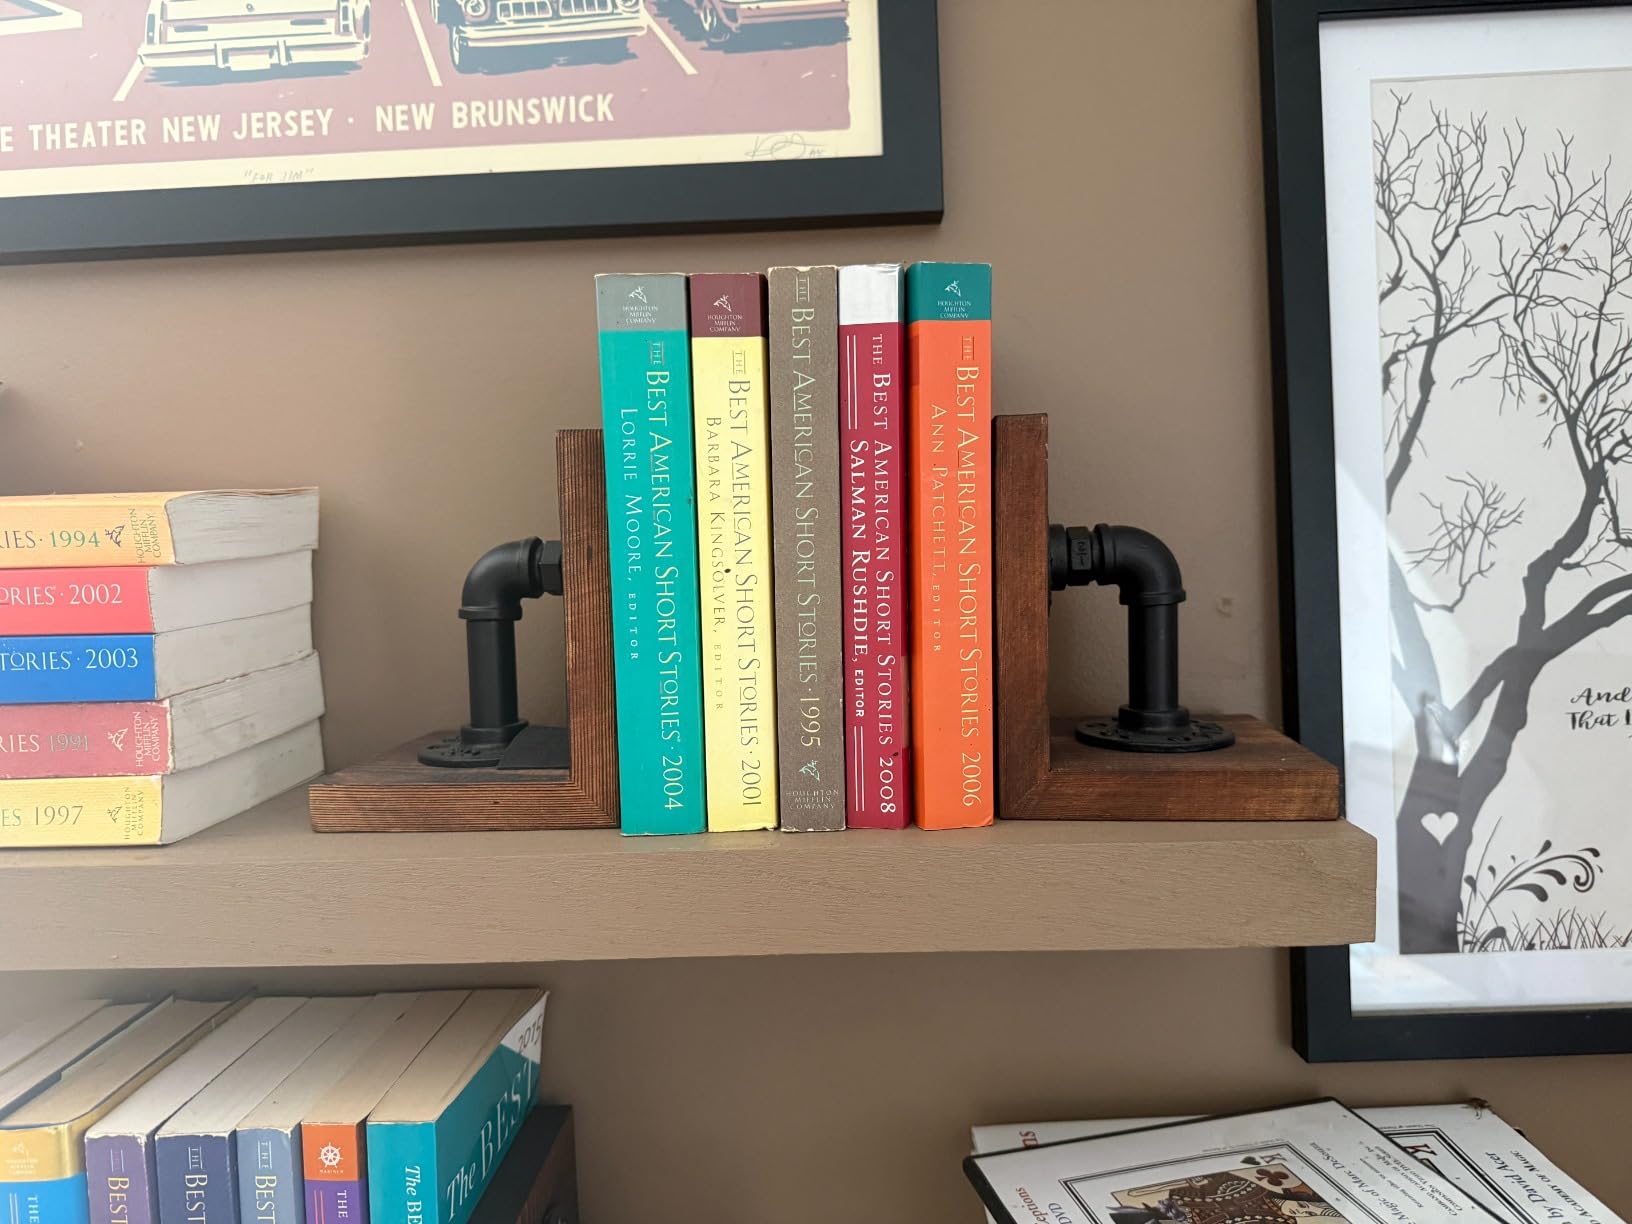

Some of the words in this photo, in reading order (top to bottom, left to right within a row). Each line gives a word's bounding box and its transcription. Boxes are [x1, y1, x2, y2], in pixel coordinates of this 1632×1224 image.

[28, 119, 147, 151] THEATER
[162, 114, 221, 144] NEW
[232, 107, 334, 141] JERSEY
[375, 103, 436, 133] NEW
[452, 93, 615, 129] BRUNSWICK
[651, 341, 662, 365] THE
[734, 351, 743, 375] THE
[791, 307, 815, 365] BEST
[872, 333, 883, 365] THE
[963, 336, 973, 361] THE
[646, 370, 670, 427] BEST
[728, 379, 751, 437] BEST
[872, 373, 891, 430] BEST
[956, 366, 980, 423] BEST
[620, 408, 639, 481] LORRIE
[793, 370, 816, 498] AMERICAN
[931, 404, 948, 454] ANN
[706, 417, 722, 502] BARBARA
[649, 432, 673, 557] AMERICAN
[731, 440, 754, 565] AMERICAN
[850, 439, 869, 540] SALMAN
[874, 440, 893, 561] AMERICAN
[957, 428, 980, 555] AMERICAN
[49, 530, 101, 549] 1994
[128, 508, 147, 564] HOUGHTON
[139, 519, 153, 553] MIFFLIN
[147, 512, 161, 558] COMPANY
[624, 494, 643, 581] MOORE,
[795, 506, 819, 589] SHORT
[932, 467, 949, 577] PATCHETT,
[69, 583, 123, 605] 2002
[710, 511, 726, 633] KINGSOLVER,
[628, 593, 639, 660] EDITOR
[654, 566, 679, 646] SHORT
[735, 573, 758, 653] SHORT
[851, 550, 871, 662] RUSHDIE,
[875, 570, 894, 645] SHORT
[932, 584, 942, 652] EDITOR
[958, 563, 982, 644] SHORT
[85, 648, 139, 669] 2003
[798, 593, 821, 684] STORIES
[713, 644, 724, 710] EDITOR
[738, 658, 761, 746] STORIES
[854, 669, 865, 718] EDITOR
[877, 654, 896, 746] STORIES
[959, 647, 983, 738] STORIES
[1570, 687, 1631, 706] And
[49, 734, 89, 753] 1991
[132, 711, 144, 767] HOUGHTON
[143, 722, 153, 757] MIFFLIN
[151, 717, 161, 762] COMPANY
[799, 698, 821, 748] 1995
[1565, 710, 1620, 730] That
[662, 755, 685, 811] 2004
[741, 759, 762, 806] 2001
[879, 757, 896, 814] 2008
[961, 751, 983, 808] 2006
[34, 806, 84, 826] 1997
[517, 1013, 544, 1053] 2015
[191, 1148, 200, 1168] THE
[446, 1161, 476, 1223] The
[480, 1059, 533, 1183] BEST
[1484, 1151, 1514, 1172] Acer
[1510, 1150, 1540, 1172] MAGIC
[107, 1177, 130, 1224] BEST
[184, 1174, 208, 1224] BEST
[255, 1175, 277, 1224] BEST
[336, 1190, 348, 1218] THE
[405, 1165, 421, 1196] The
[1378, 1197, 1410, 1220] Magic
[1503, 1174, 1548, 1203] David
[1547, 1184, 1593, 1218] ACADEMY
[28, 1194, 40, 1224] THE
[1543, 1205, 1564, 1219] by
